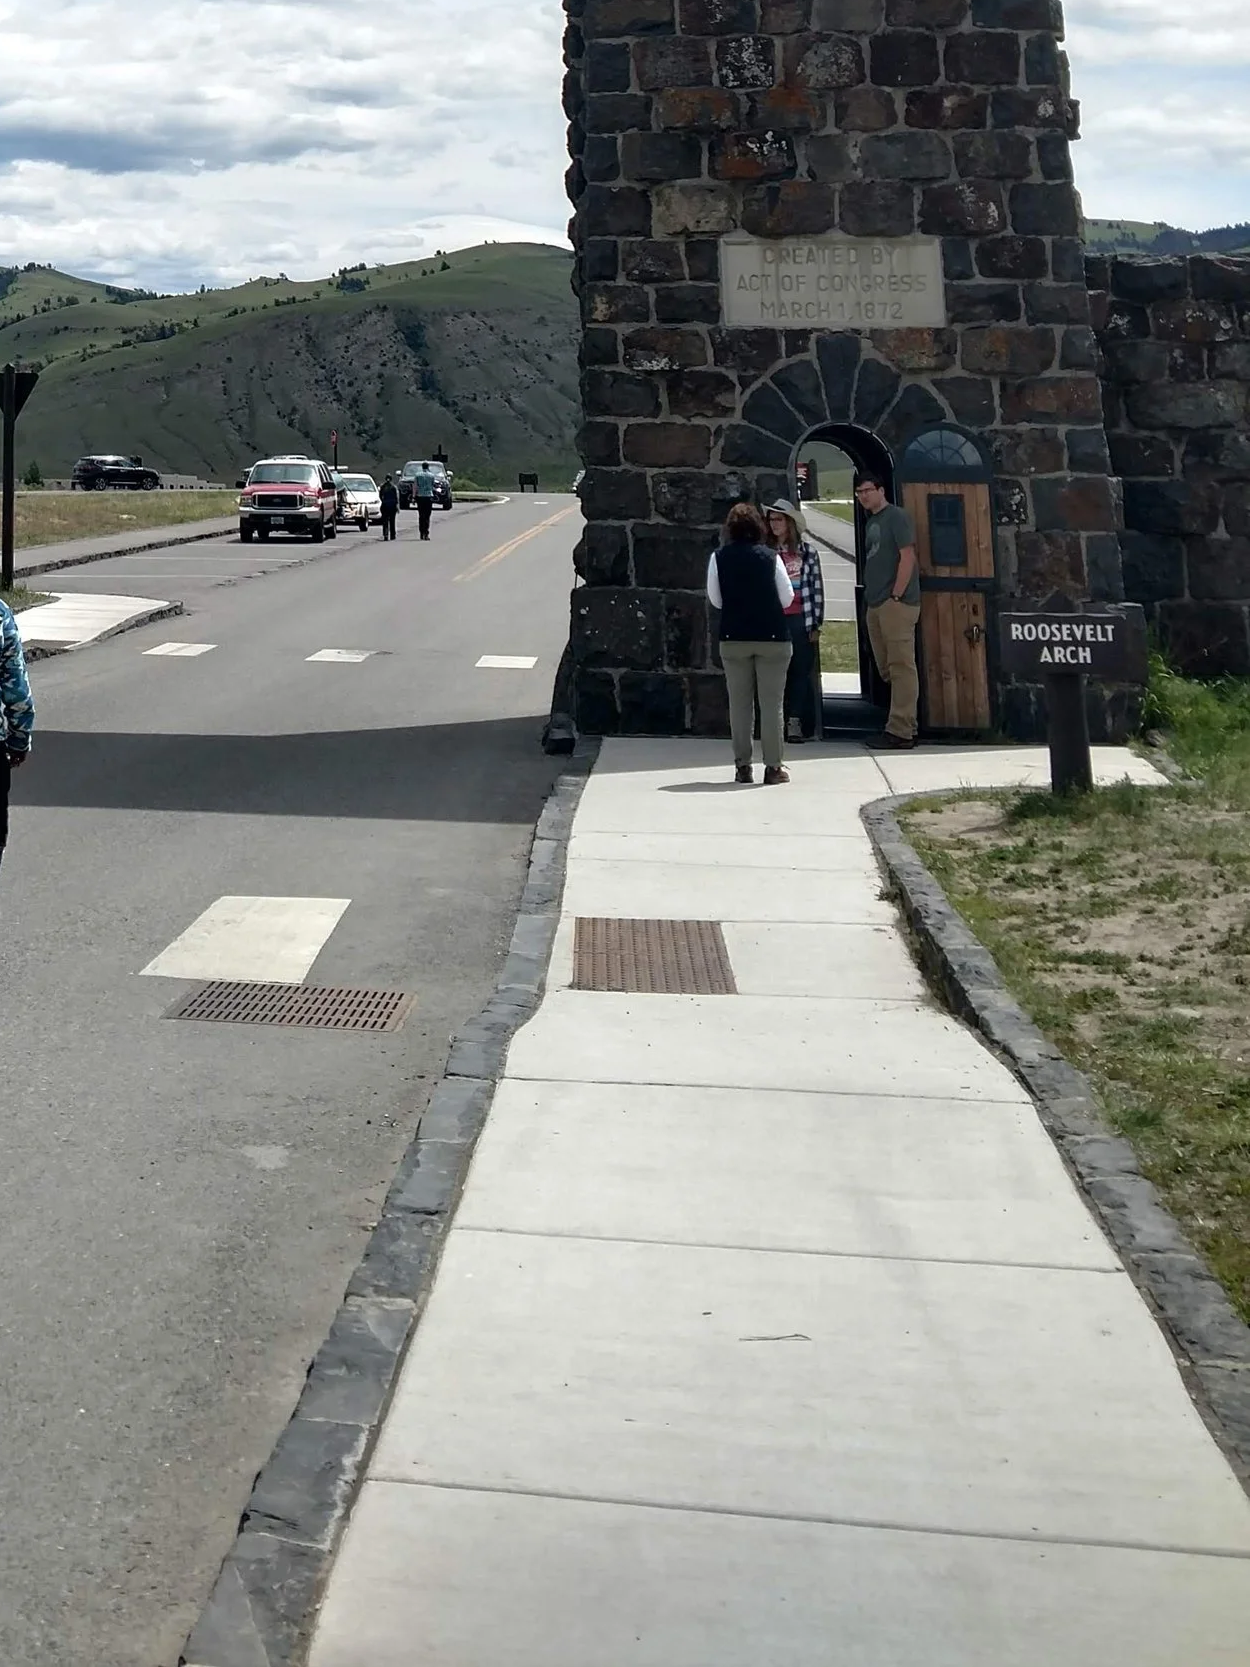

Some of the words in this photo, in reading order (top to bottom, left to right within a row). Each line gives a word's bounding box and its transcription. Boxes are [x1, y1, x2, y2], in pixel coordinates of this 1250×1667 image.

[762, 246, 859, 265] CREATED
[871, 245, 897, 266] BY
[736, 274, 772, 292] ACT
[781, 274, 807, 292] OF
[817, 274, 928, 293] CONGRESS
[760, 301, 831, 320] MARCH
[1010, 623, 1115, 642] ROOSEVELT
[1039, 646, 1092, 664] ARCH
